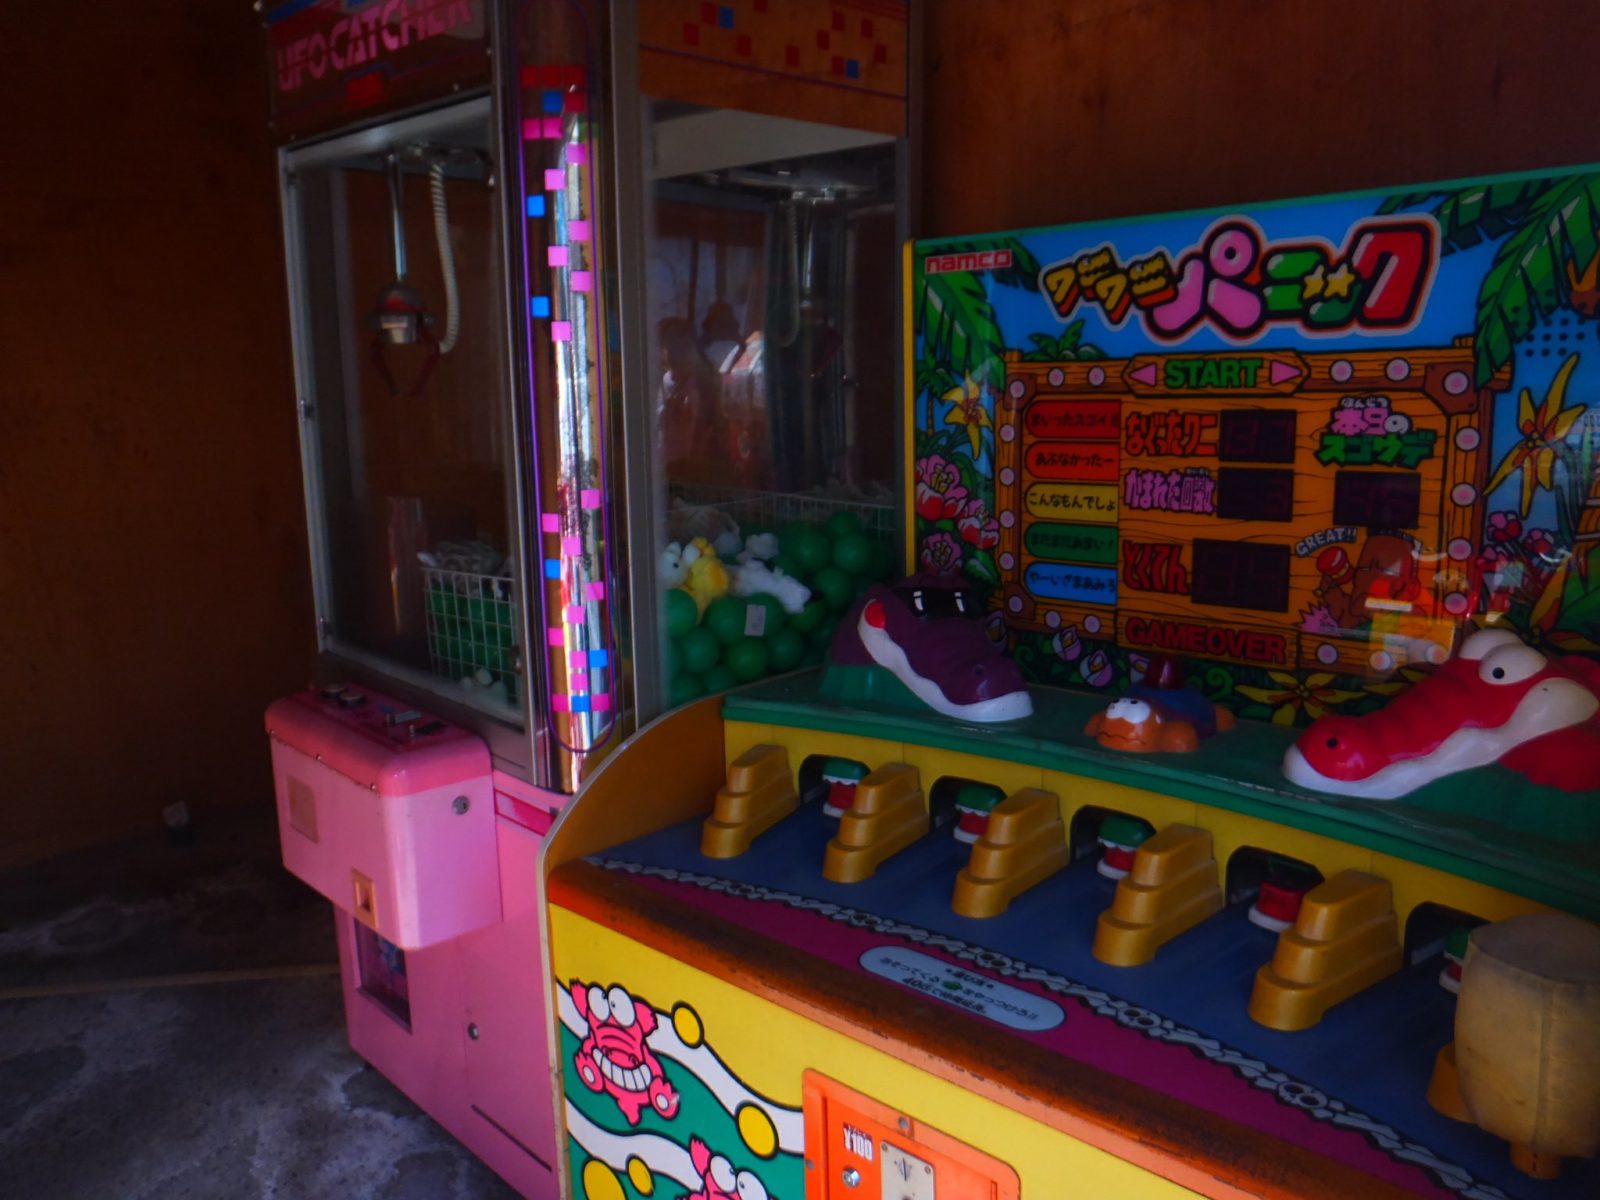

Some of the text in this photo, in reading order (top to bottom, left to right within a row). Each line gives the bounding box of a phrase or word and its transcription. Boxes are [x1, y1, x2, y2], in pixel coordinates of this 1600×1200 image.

[275, 32, 328, 93] UFO
[925, 248, 1013, 274] namco
[1040, 216, 1438, 343] ワニワニパニック
[1163, 357, 1264, 389] START
[1329, 406, 1413, 436] 本日の
[1317, 428, 1437, 469] スゴウデ
[1028, 490, 1117, 512] こんなもんでしょ
[1295, 526, 1359, 557] GREAT!!
[1122, 540, 1191, 596] とくてん
